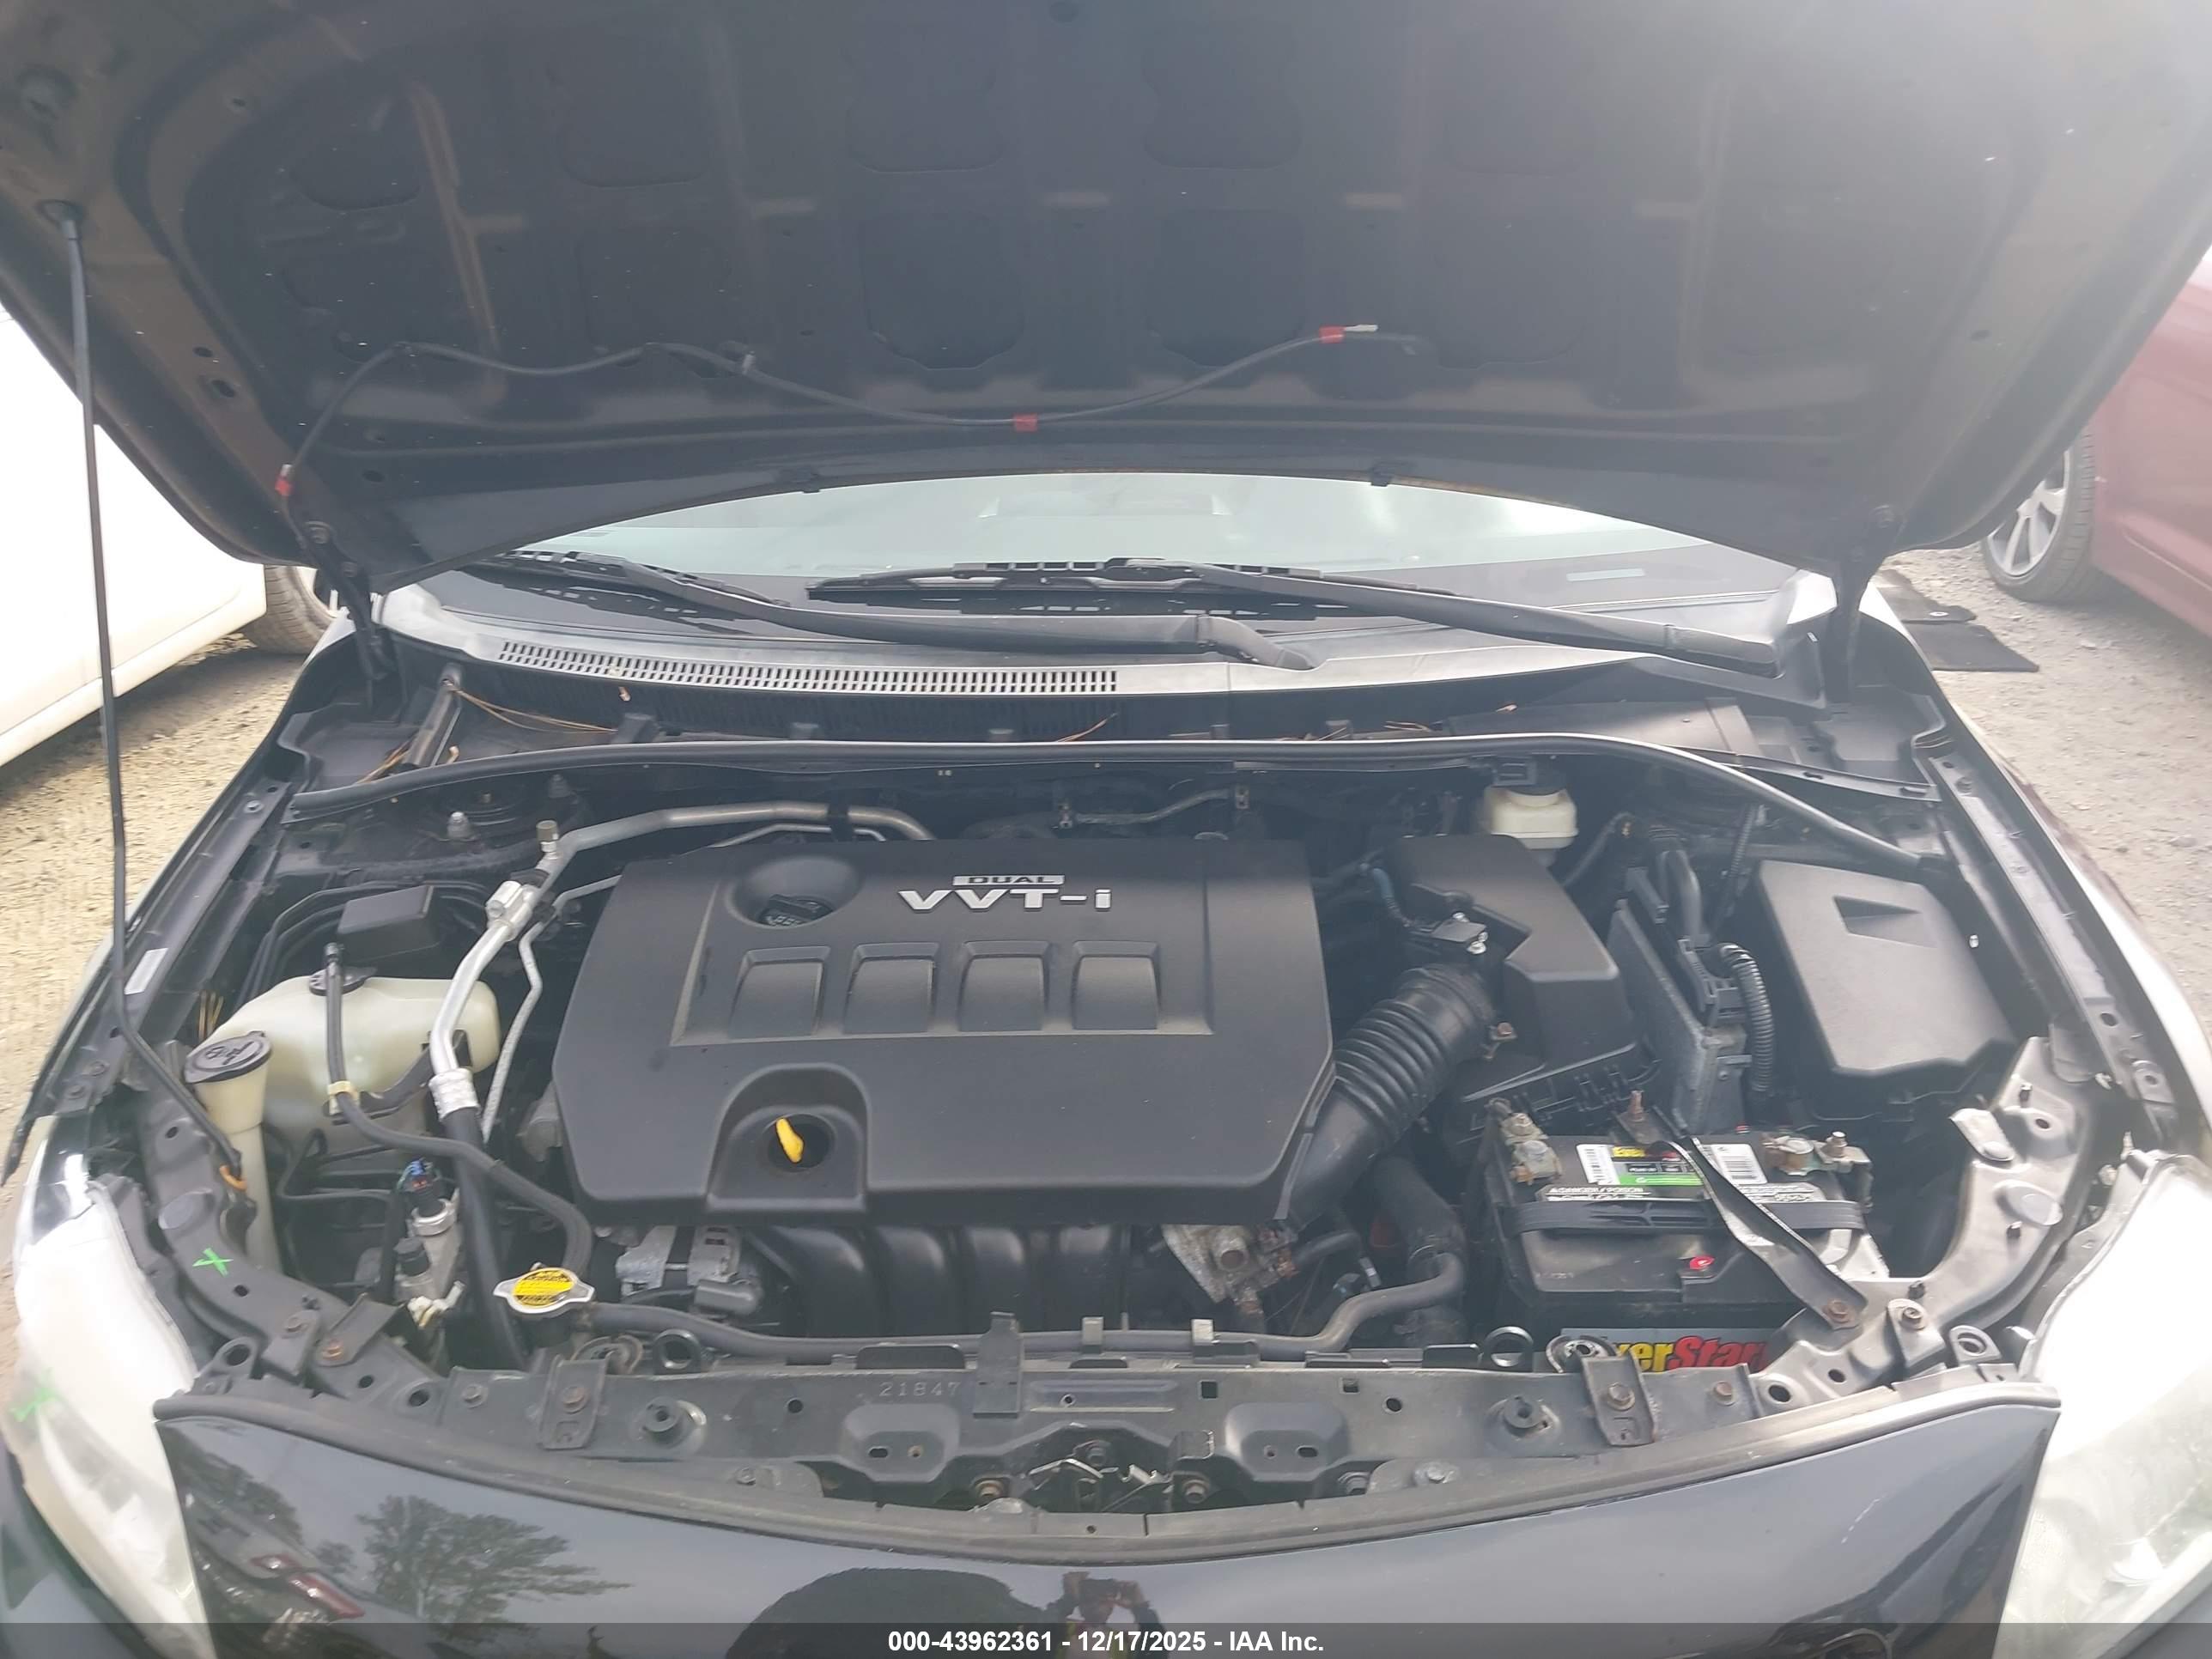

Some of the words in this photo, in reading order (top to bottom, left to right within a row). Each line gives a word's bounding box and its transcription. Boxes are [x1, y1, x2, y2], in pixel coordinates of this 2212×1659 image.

[966, 876, 1056, 884] DUAL
[897, 888, 1112, 912] VVT-i
[878, 1380, 962, 1397] 21847
